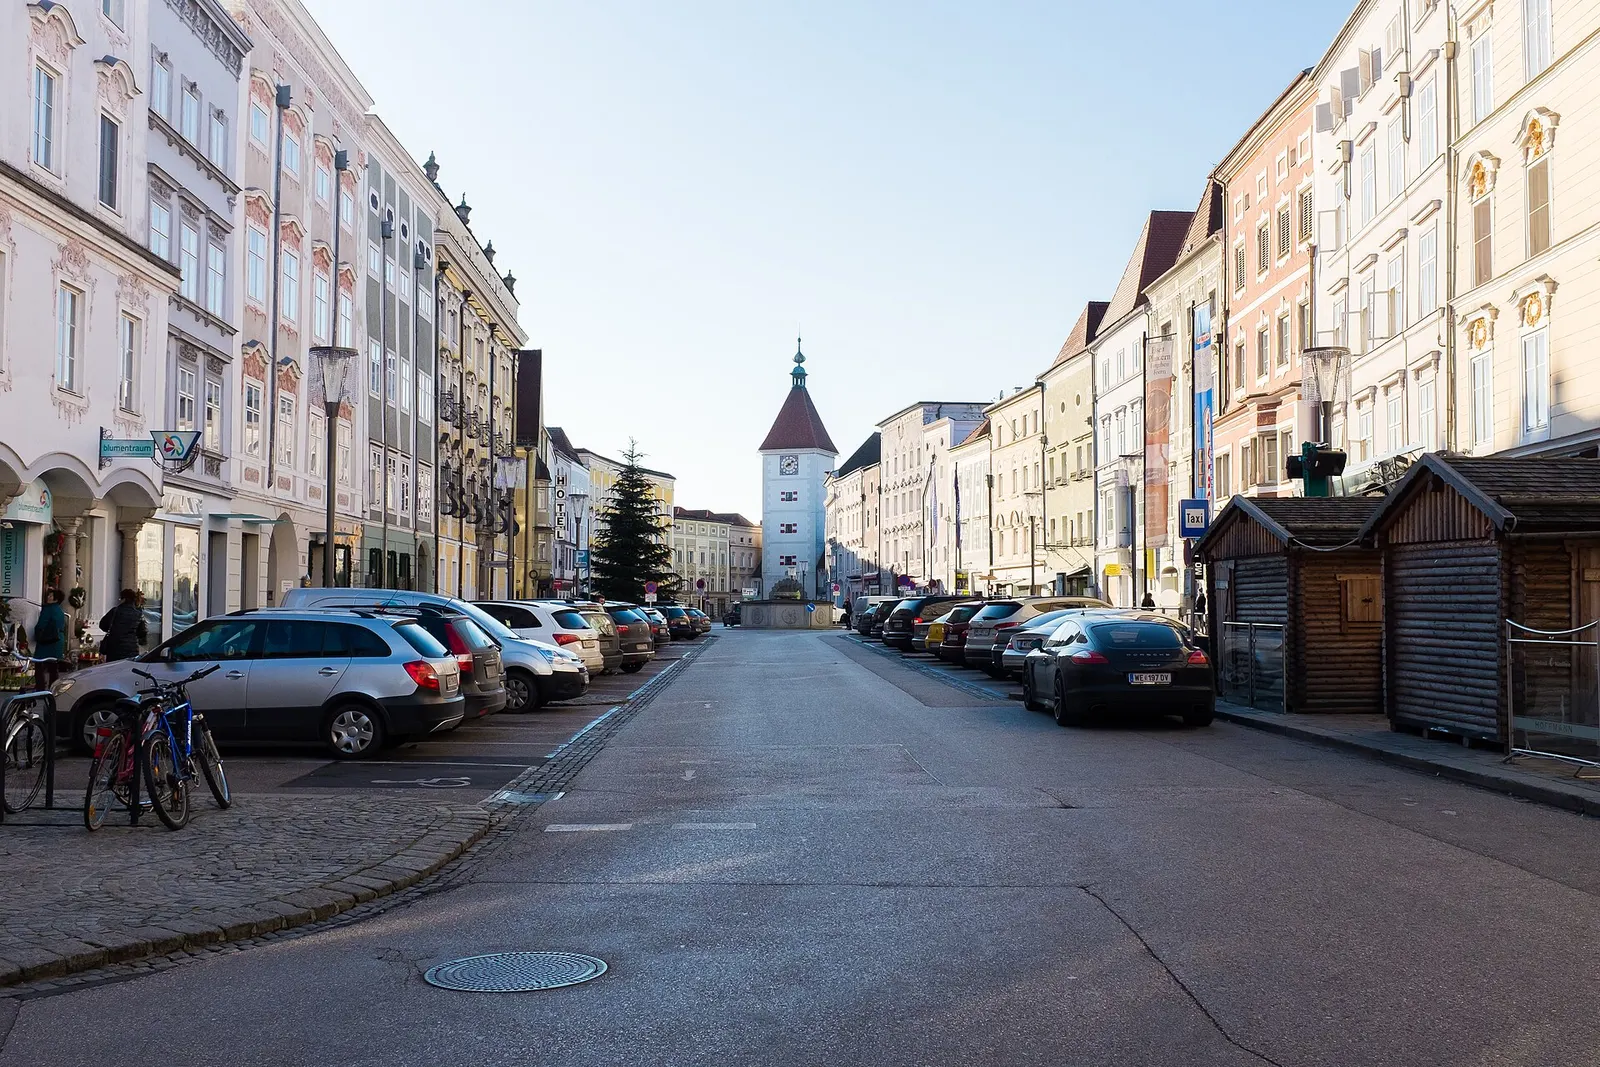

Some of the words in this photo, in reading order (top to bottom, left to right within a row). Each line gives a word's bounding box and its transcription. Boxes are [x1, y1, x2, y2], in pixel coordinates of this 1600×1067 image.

[103, 444, 152, 452] blumentraum
[556, 476, 565, 539] HOTEL
[1186, 513, 1203, 524] Taxi
[2, 531, 12, 595] blumentraum
